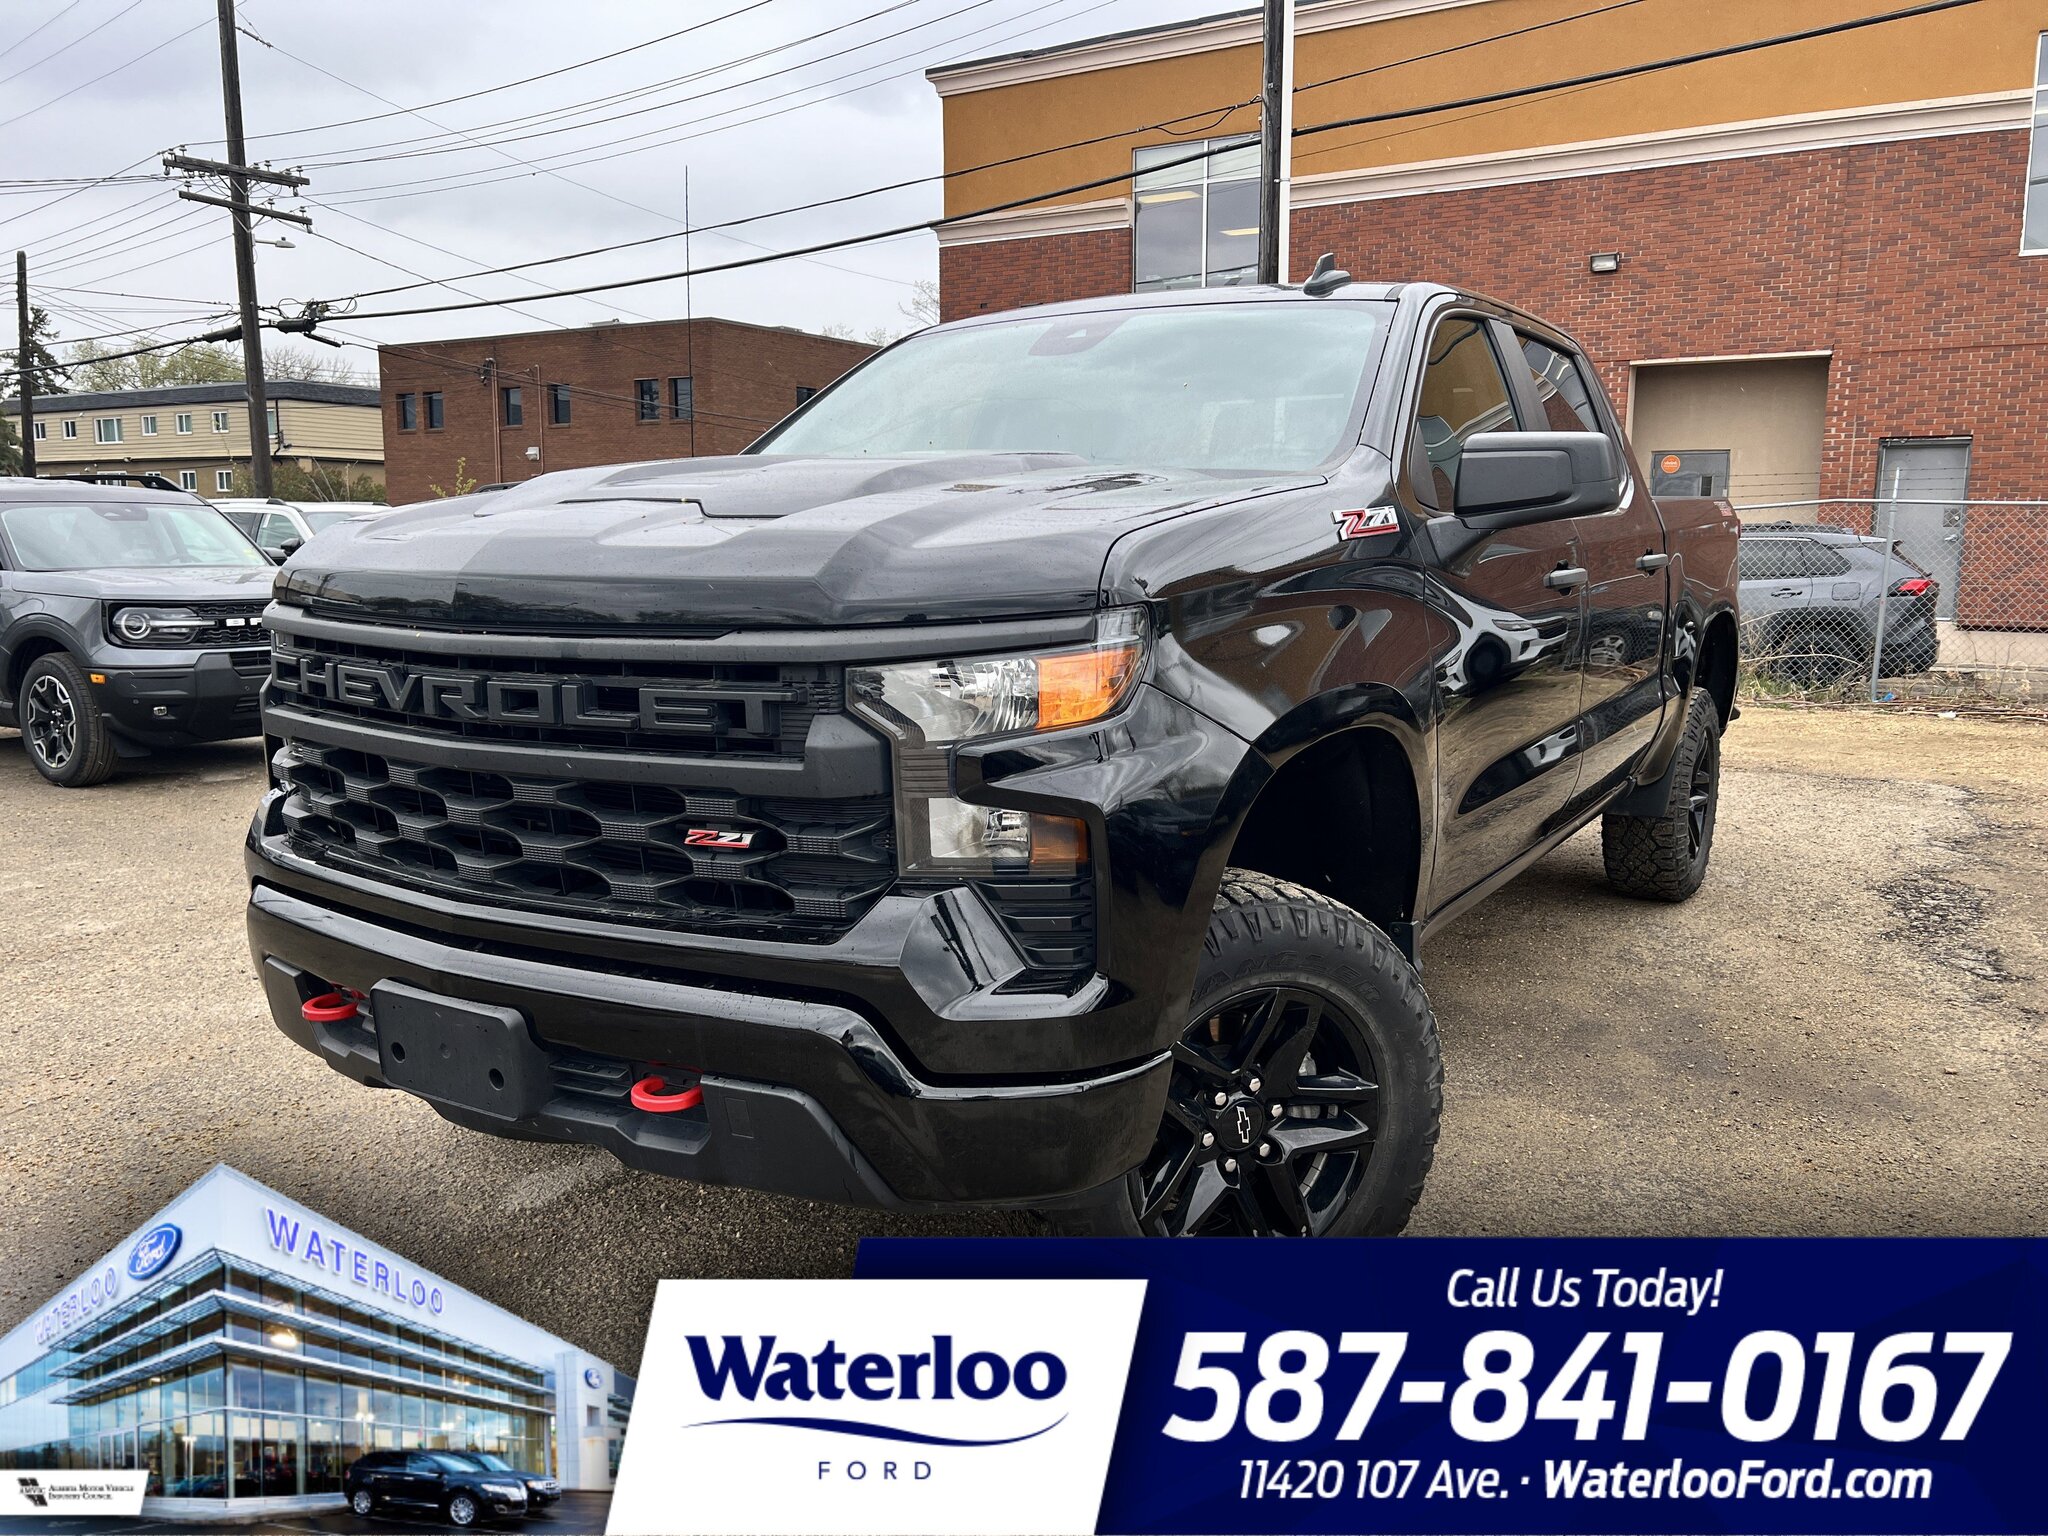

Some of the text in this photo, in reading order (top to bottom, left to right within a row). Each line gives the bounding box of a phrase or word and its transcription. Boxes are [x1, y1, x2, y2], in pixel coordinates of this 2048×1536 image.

[1330, 506, 1400, 541] Z71
[271, 652, 802, 737] CHEVROLET
[684, 829, 754, 848] Z71
